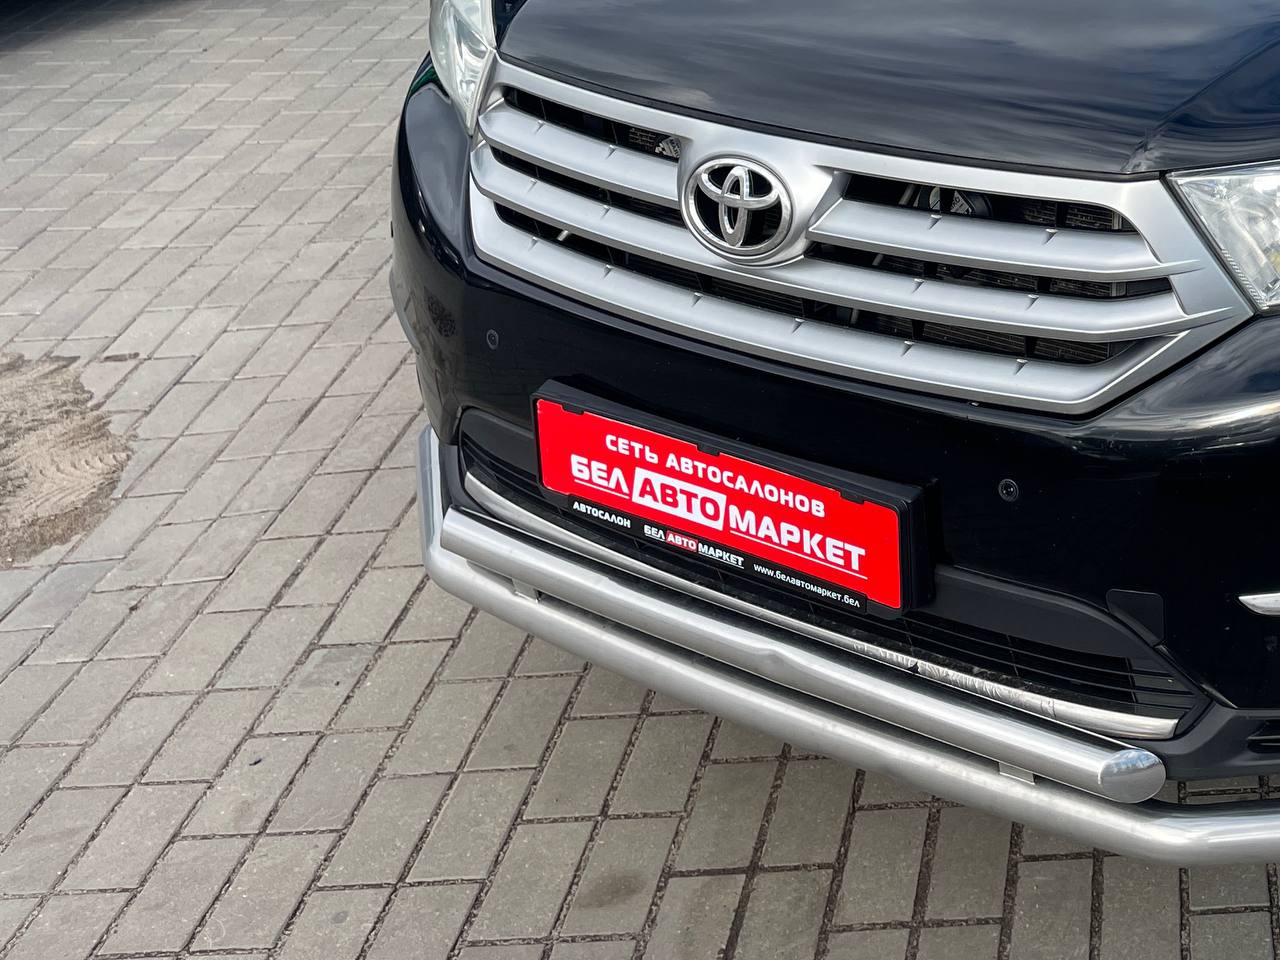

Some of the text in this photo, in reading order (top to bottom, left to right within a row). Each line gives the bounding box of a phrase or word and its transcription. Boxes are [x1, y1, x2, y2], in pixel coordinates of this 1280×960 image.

[570, 453, 866, 572] БЕЛ АВТО МАРКЕТ
[605, 434, 826, 518] СЕТЬ АВТОСАЛОНОВ
[572, 500, 632, 529] АВТОСАЛОН
[643, 524, 665, 541] БЕЛ
[667, 532, 697, 551] АВТО
[698, 542, 745, 568] МАРКЕТ
